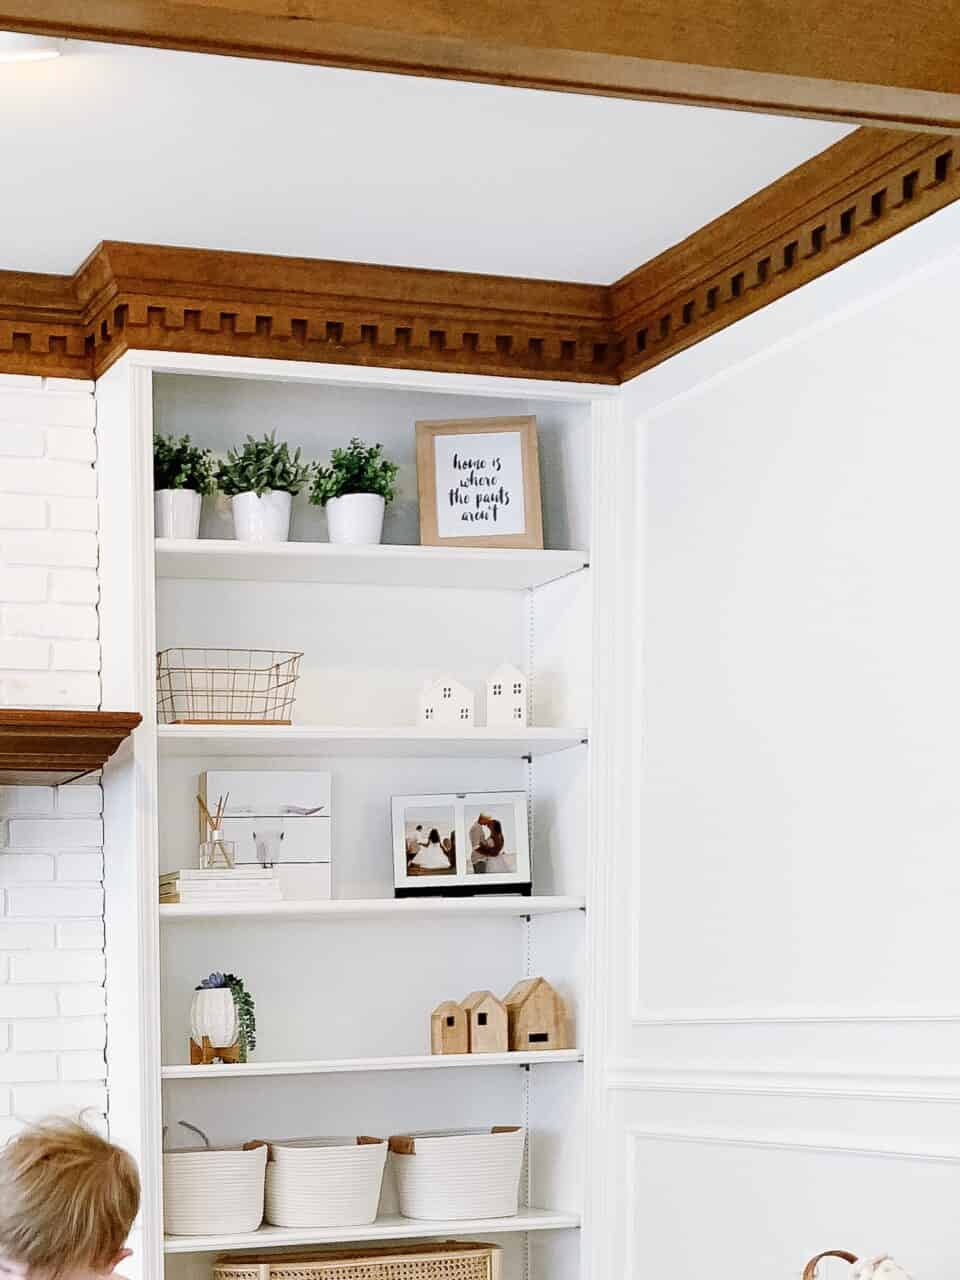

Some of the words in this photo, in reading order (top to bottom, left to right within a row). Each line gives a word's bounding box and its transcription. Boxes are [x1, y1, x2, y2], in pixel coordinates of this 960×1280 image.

[453, 453, 487, 470] home
[492, 457, 502, 471] is
[460, 470, 498, 488] where
[448, 488, 470, 506] the
[476, 486, 510, 508] pants
[461, 504, 498, 522] aren't
